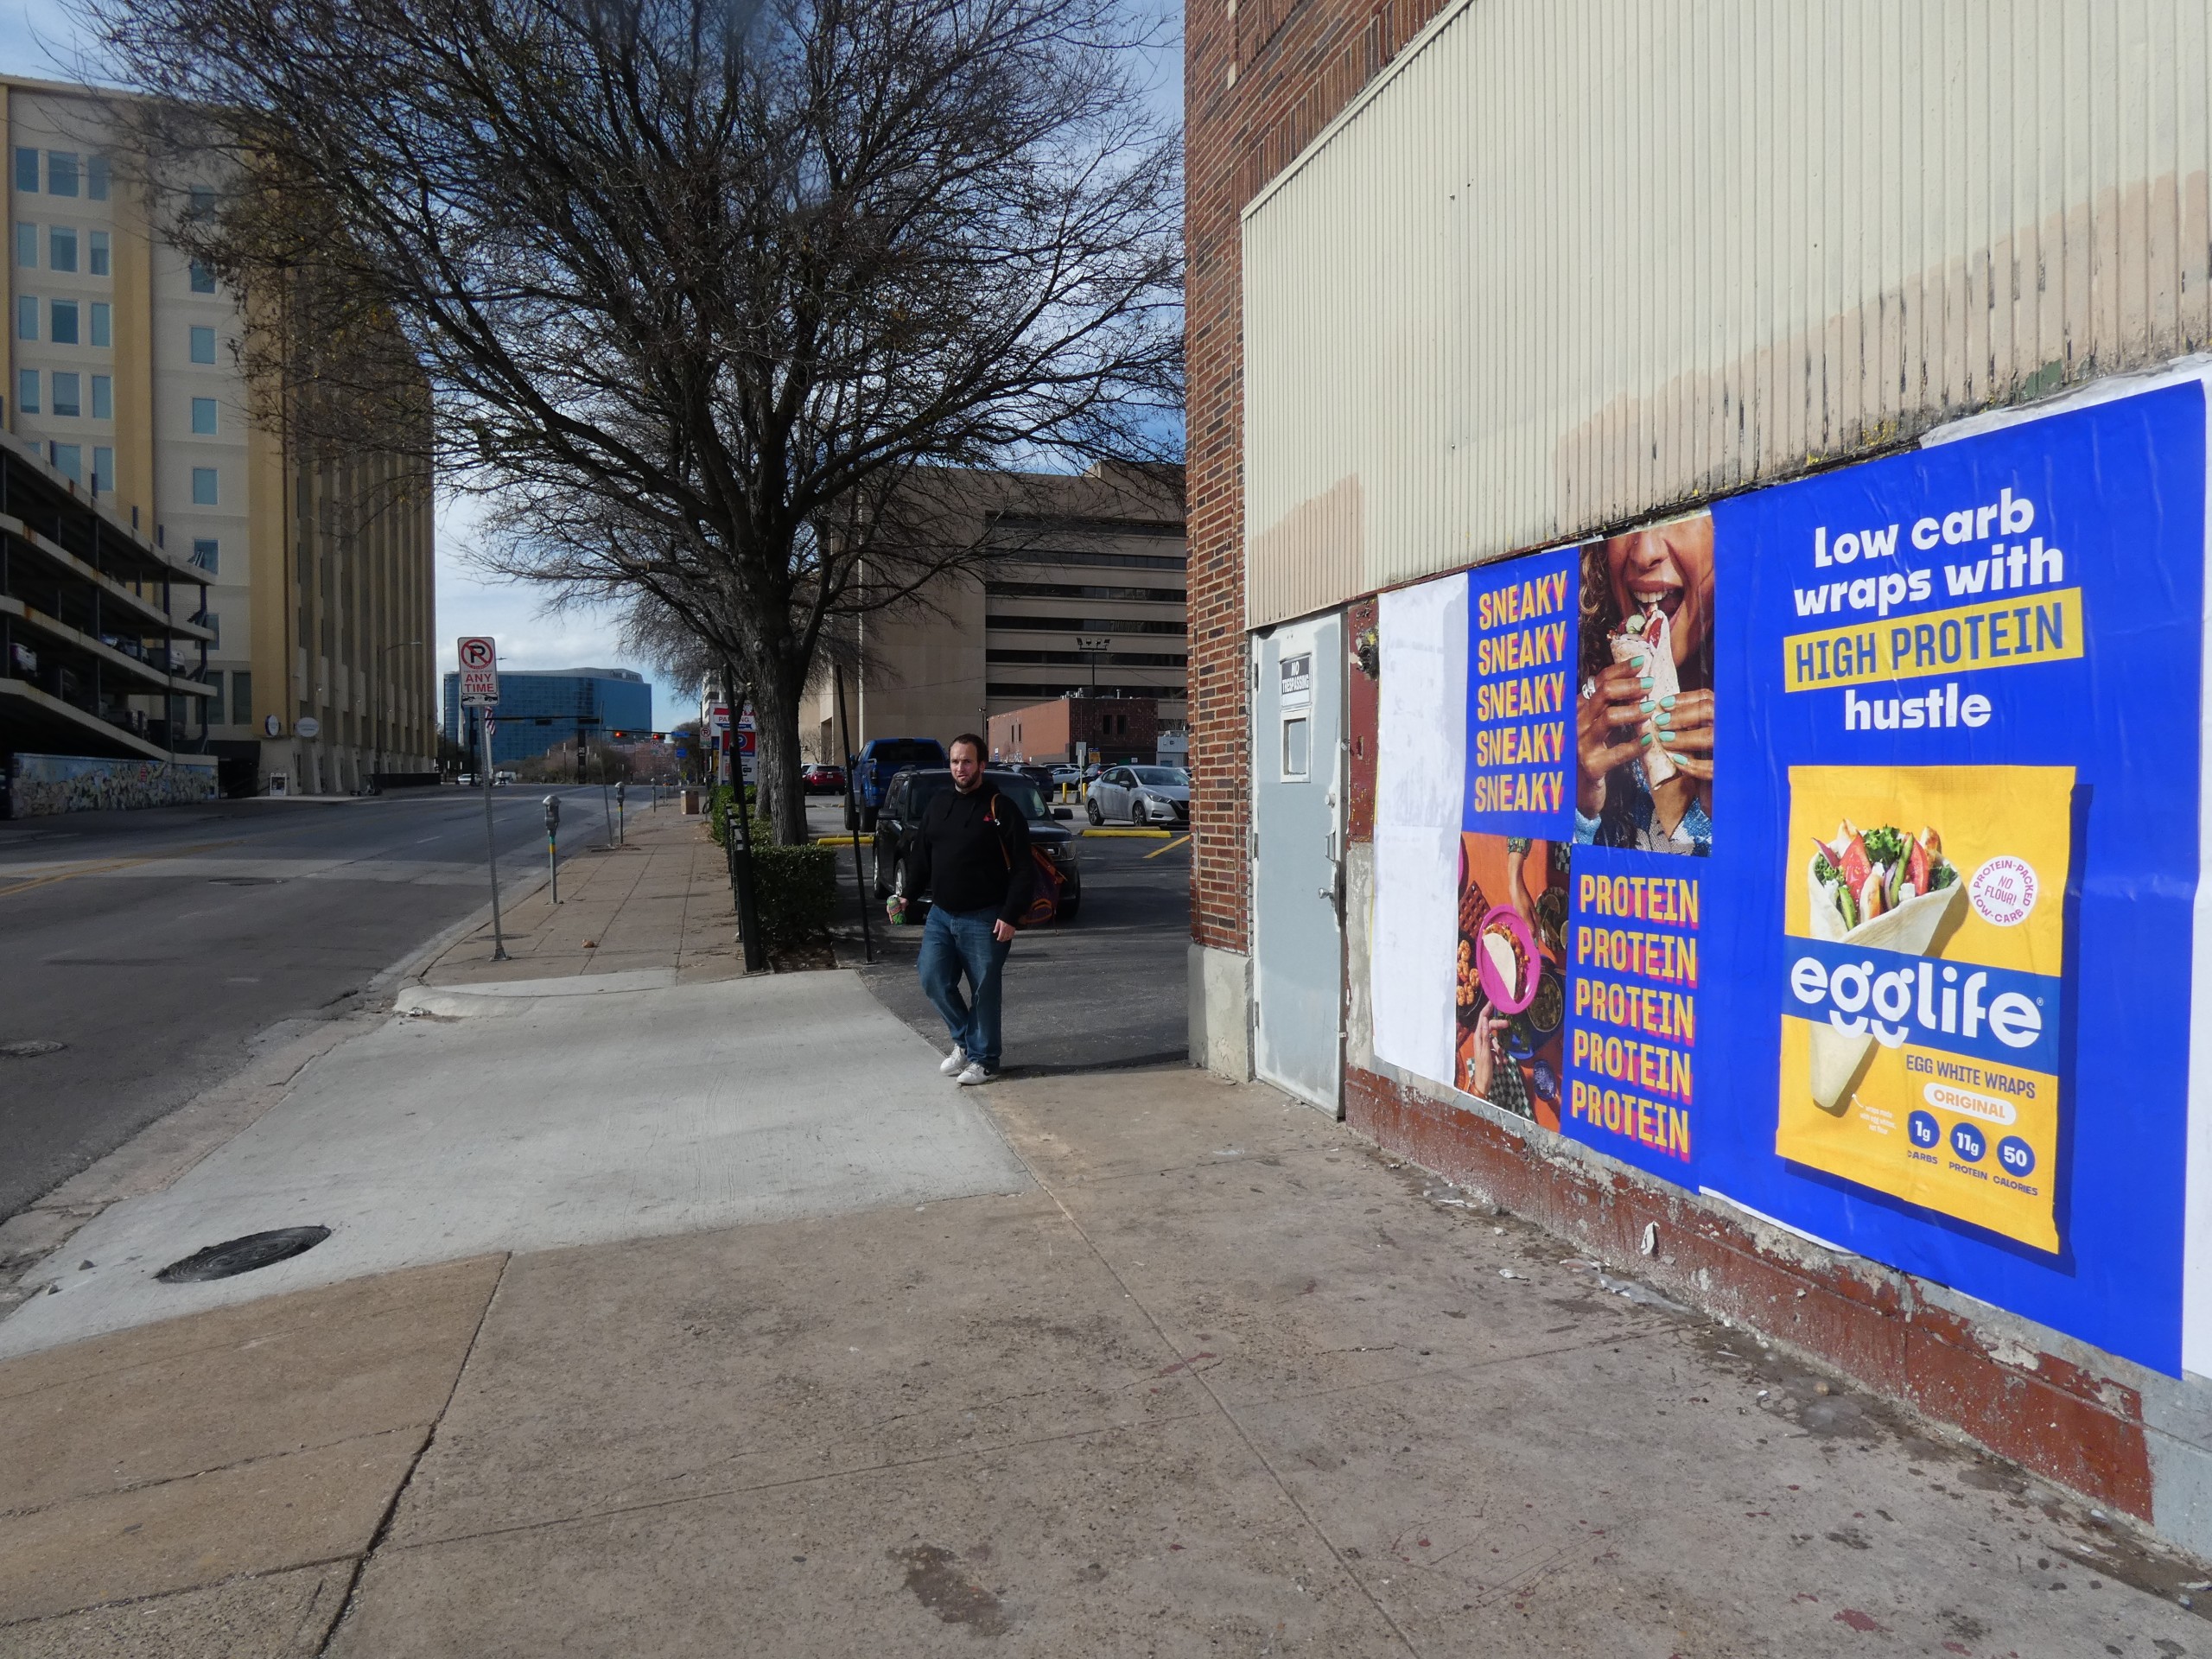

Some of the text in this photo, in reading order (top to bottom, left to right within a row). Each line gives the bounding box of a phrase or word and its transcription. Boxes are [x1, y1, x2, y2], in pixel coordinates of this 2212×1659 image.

[1815, 487, 2035, 569] Low carb
[1794, 537, 2064, 617] wraps with
[1478, 570, 1568, 631] SNEAKY
[1478, 621, 1567, 677] SNEAKY
[1796, 601, 2063, 683] HIGH PROTEIN
[464, 683, 494, 692] TIME
[465, 674, 492, 683] ANY
[1282, 674, 1309, 694] TRESPASSING
[1291, 660, 1300, 677] NO
[1477, 671, 1567, 722] SNEAKY
[1845, 683, 1992, 730] hustle
[1476, 721, 1566, 768] SNEAKY
[1474, 771, 1564, 814] SNEAKY
[1579, 874, 1700, 927] PROTEIN
[1984, 885, 2018, 906] FLOUR!
[1998, 875, 2013, 889] NO
[1974, 894, 2024, 923] LOW-CARB
[1577, 925, 1698, 987] PROTEIN
[1574, 977, 1694, 1043] PROTEIN
[1790, 957, 2043, 1049] egglife
[1572, 1029, 1692, 1099] PROTEIN
[1906, 1054, 2036, 1099] EGG WHITE WRAPS
[1570, 1079, 1690, 1162] PROTEIN
[1933, 1089, 2005, 1119] ORIGINAL
[1915, 1121, 1931, 1142] 1g
[1957, 1133, 1980, 1156] 11g
[1948, 1161, 1987, 1180] PROTEIN
[2004, 1145, 2027, 1166] 50
[1993, 1176, 2038, 1196] CALORIES
